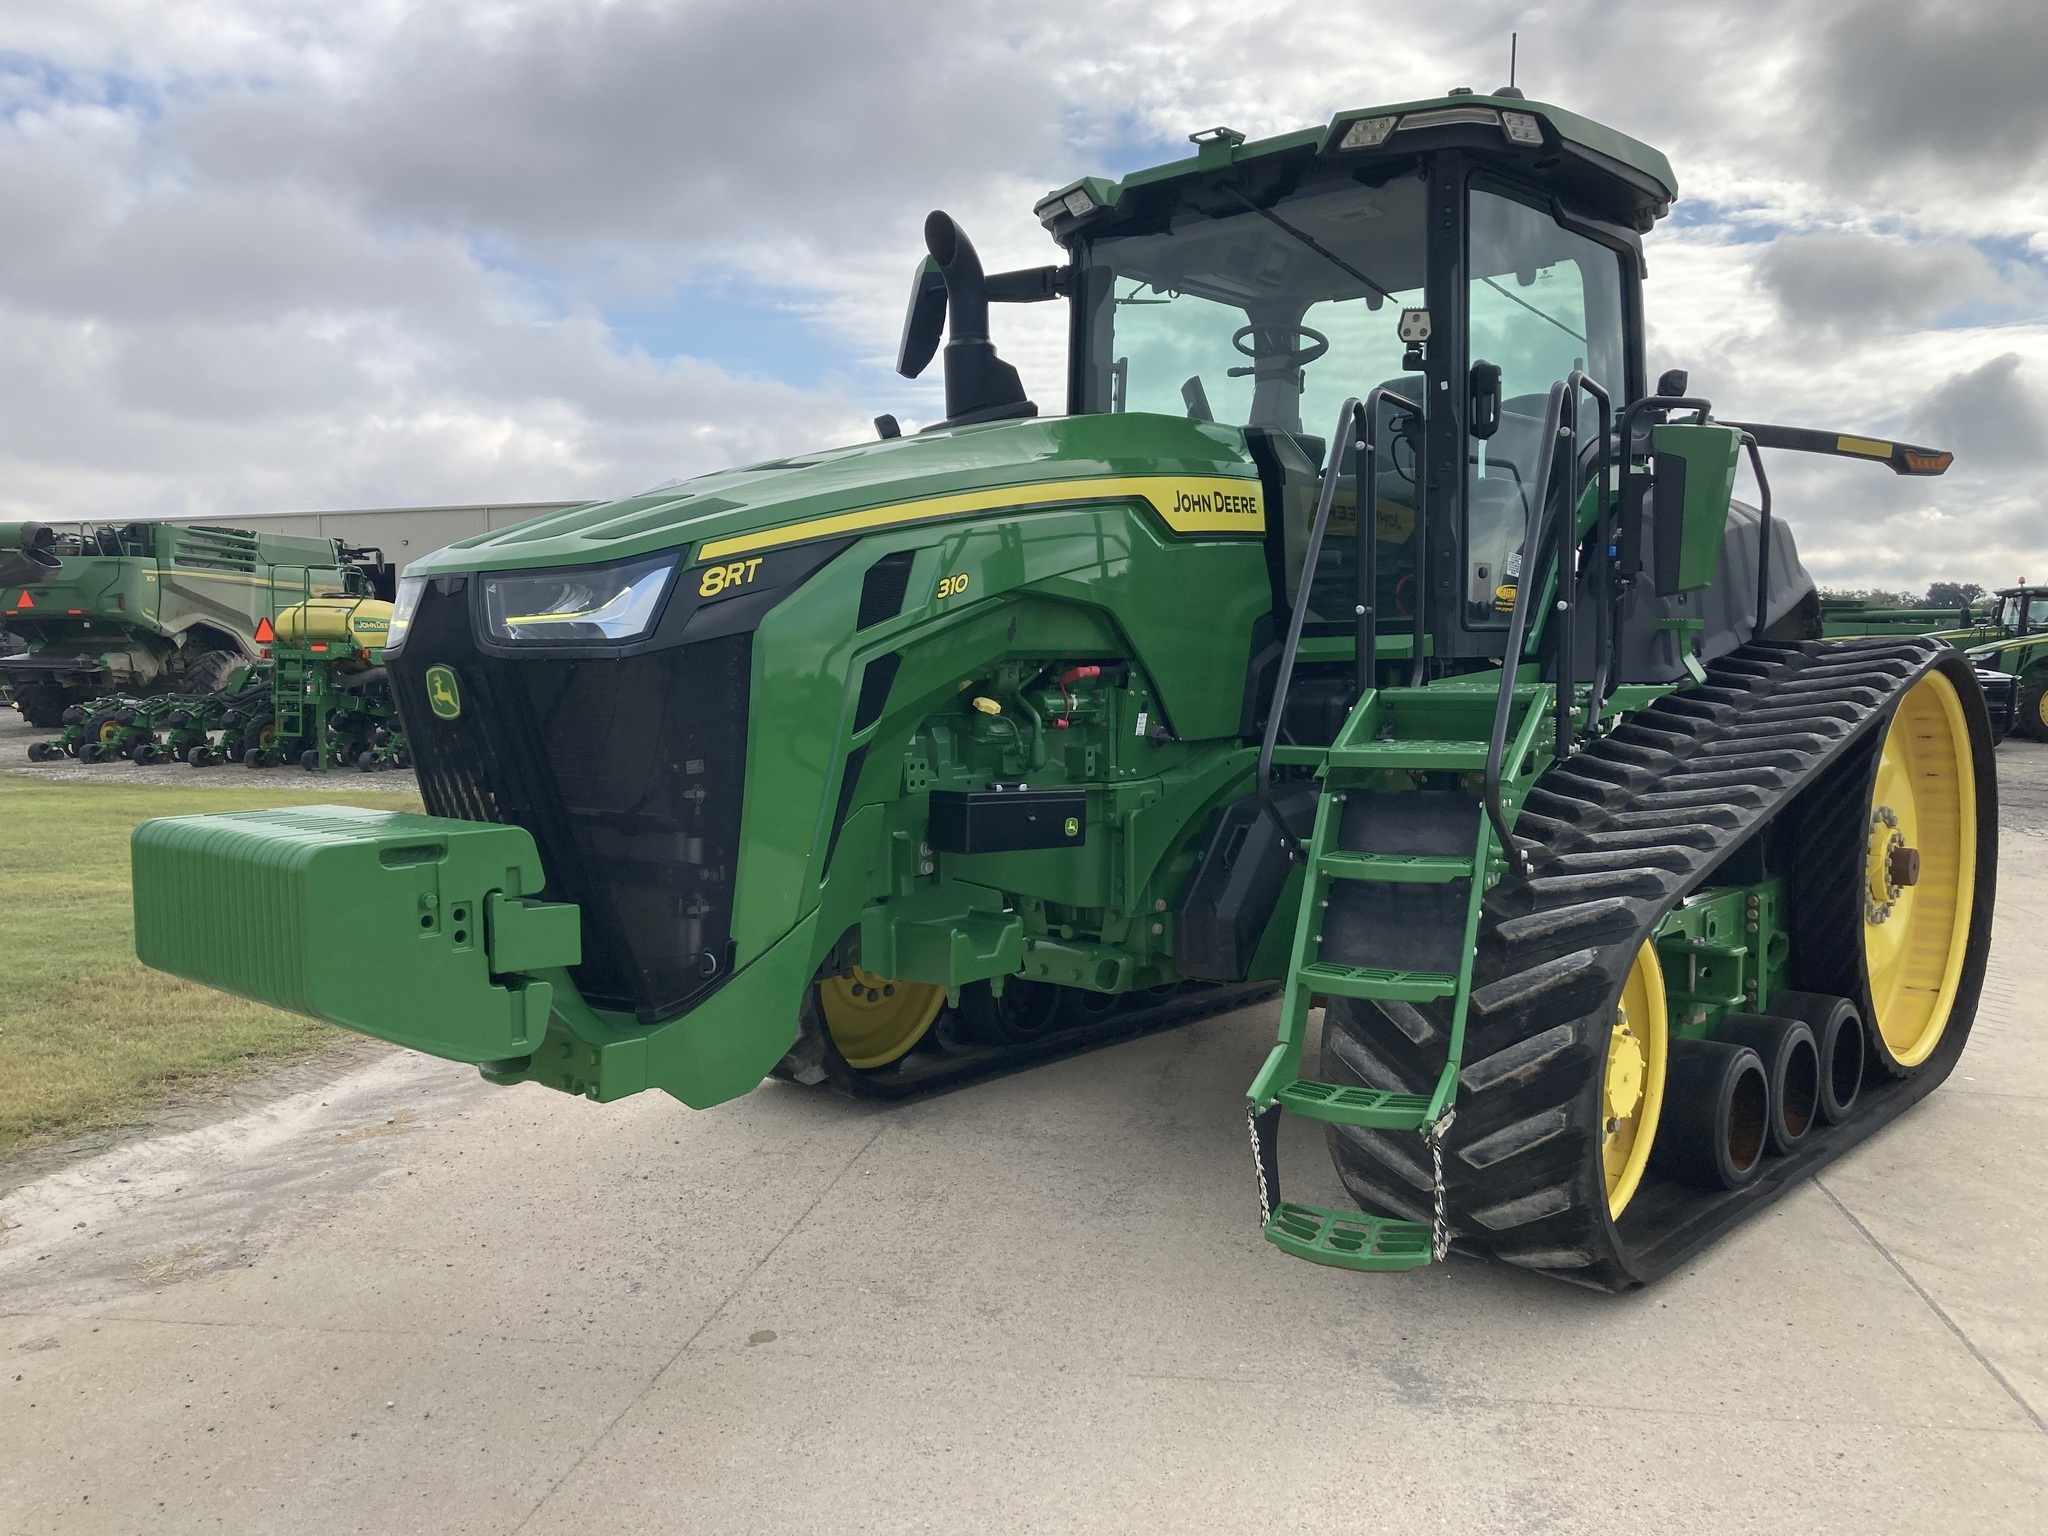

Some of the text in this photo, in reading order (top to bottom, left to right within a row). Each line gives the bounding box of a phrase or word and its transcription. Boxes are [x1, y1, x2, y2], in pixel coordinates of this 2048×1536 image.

[1173, 490, 1257, 514] JOHN DEERE
[699, 557, 763, 597] 8RT
[937, 573, 969, 599] 310
[358, 621, 390, 629] JOHN DEE
